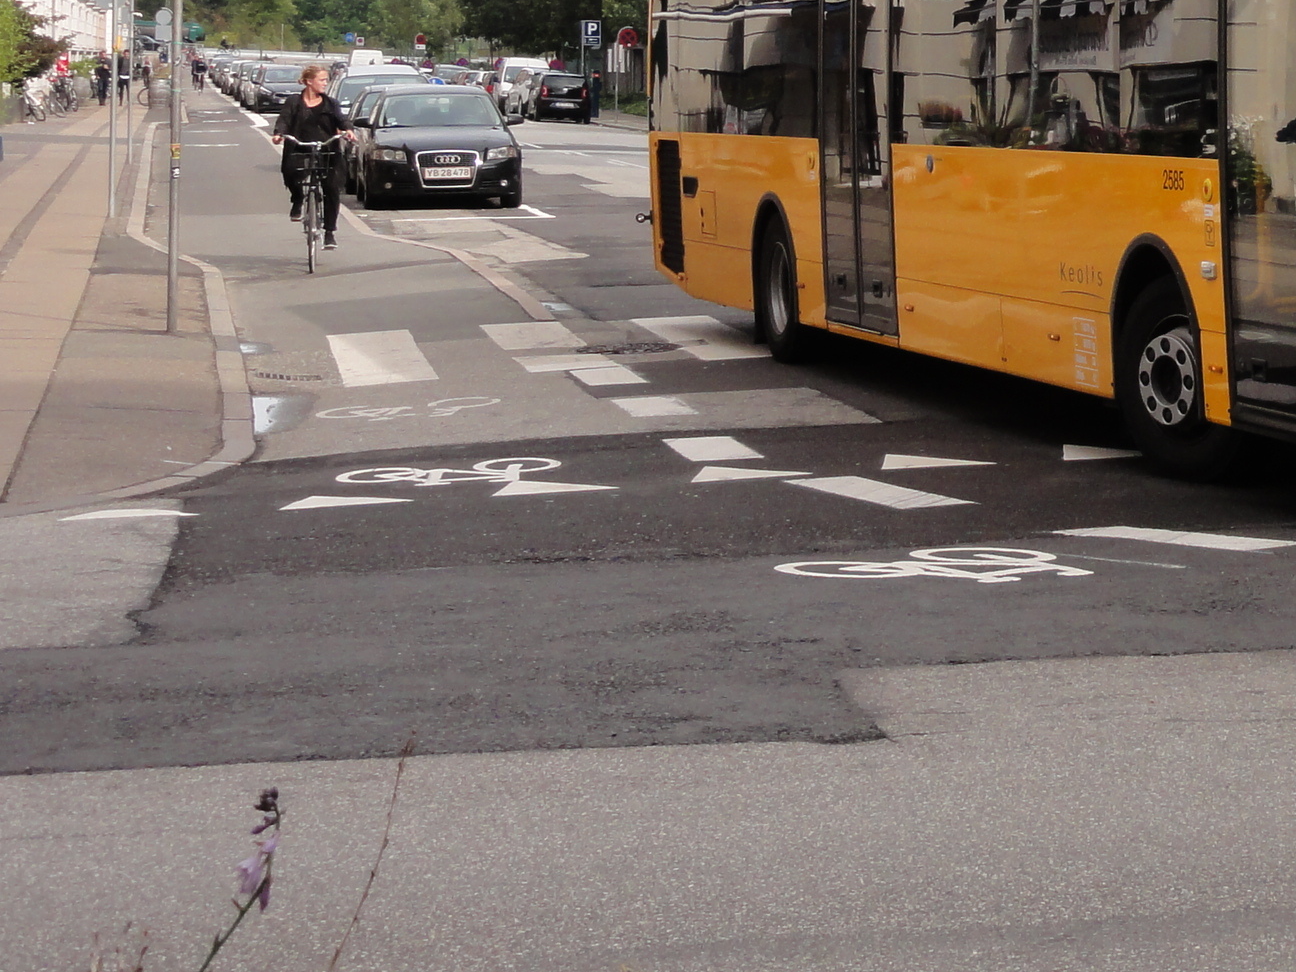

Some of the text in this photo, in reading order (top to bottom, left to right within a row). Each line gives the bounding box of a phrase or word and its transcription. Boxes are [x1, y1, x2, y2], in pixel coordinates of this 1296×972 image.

[587, 22, 598, 36] P
[427, 169, 440, 177] YB
[1163, 169, 1185, 191] 2585
[1060, 261, 1103, 287] Keolis
